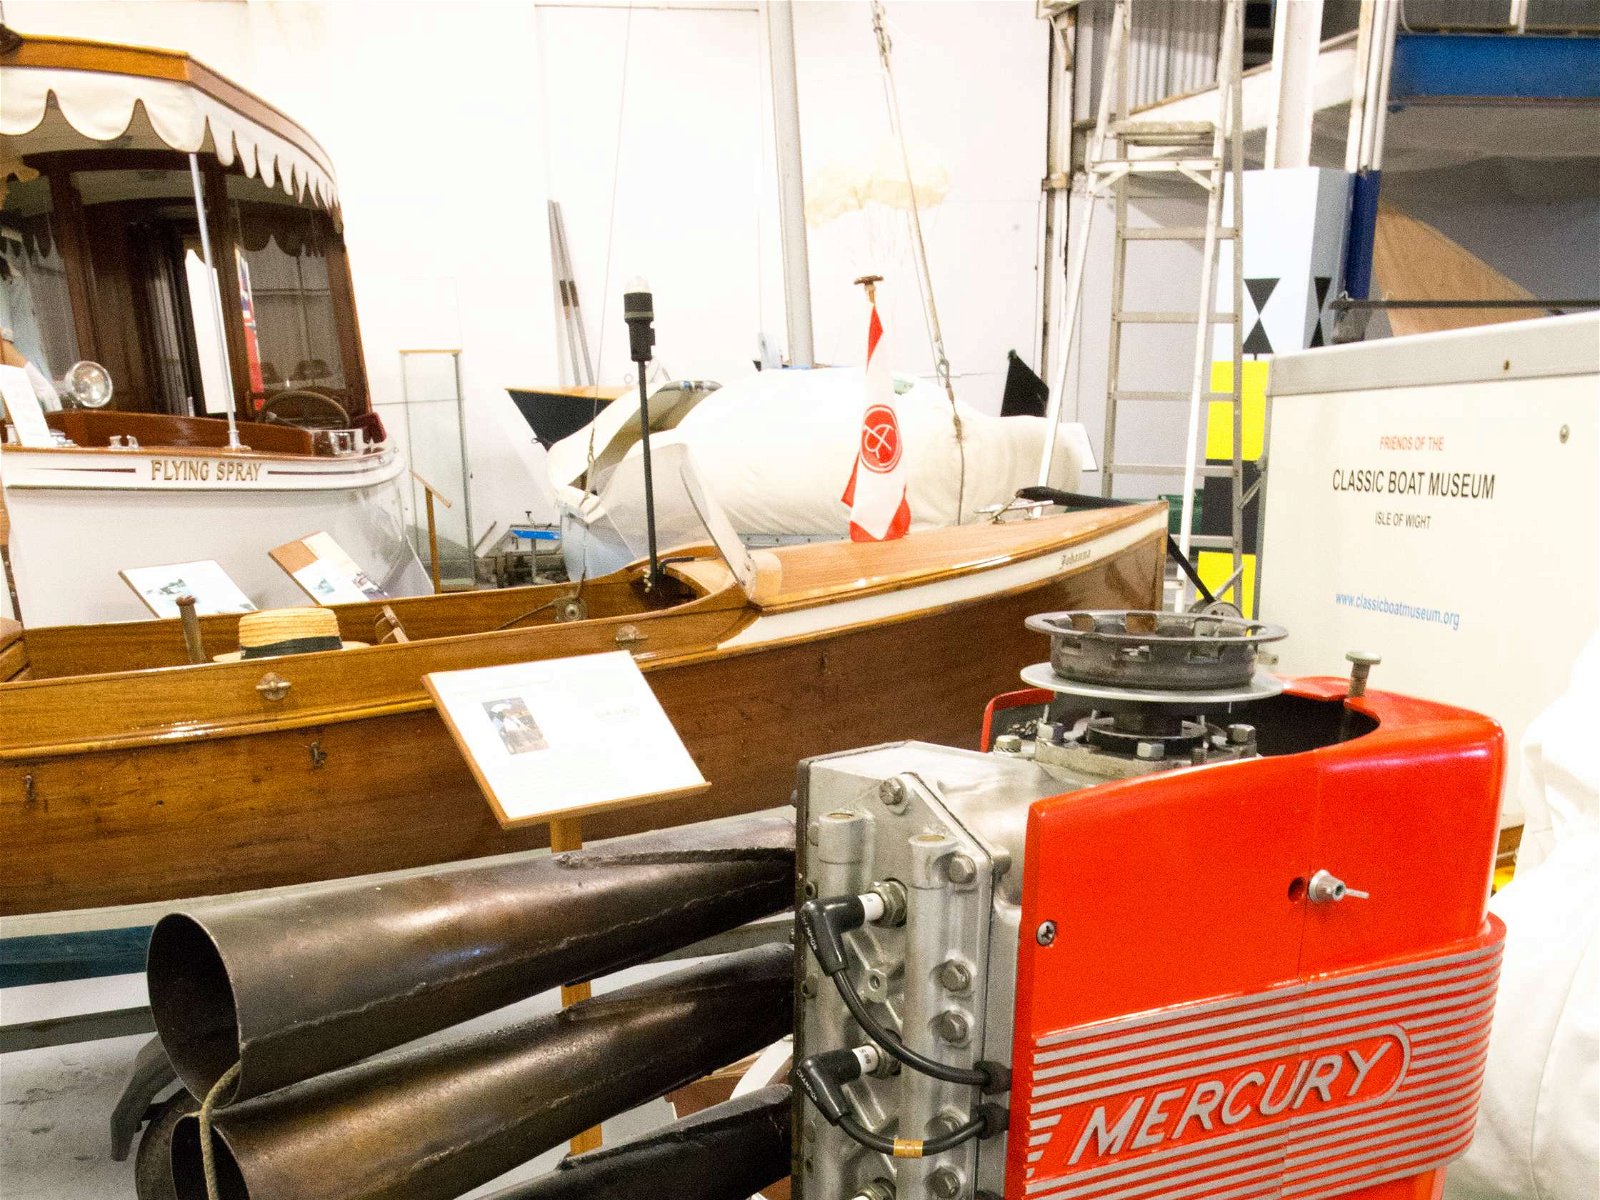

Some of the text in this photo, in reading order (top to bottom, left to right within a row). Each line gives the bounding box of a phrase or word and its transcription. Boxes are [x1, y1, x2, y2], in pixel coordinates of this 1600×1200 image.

[1379, 435, 1444, 451] FRIENDS OF THE
[151, 459, 262, 481] FLYING SPRAY
[1332, 469, 1495, 499] CLASSIC BOAT MUSEUM
[1374, 511, 1432, 529] ISLE OF WIGHT
[1335, 591, 1460, 631] www.classicboatmuseum.org
[1067, 1041, 1392, 1166] MERCURY
